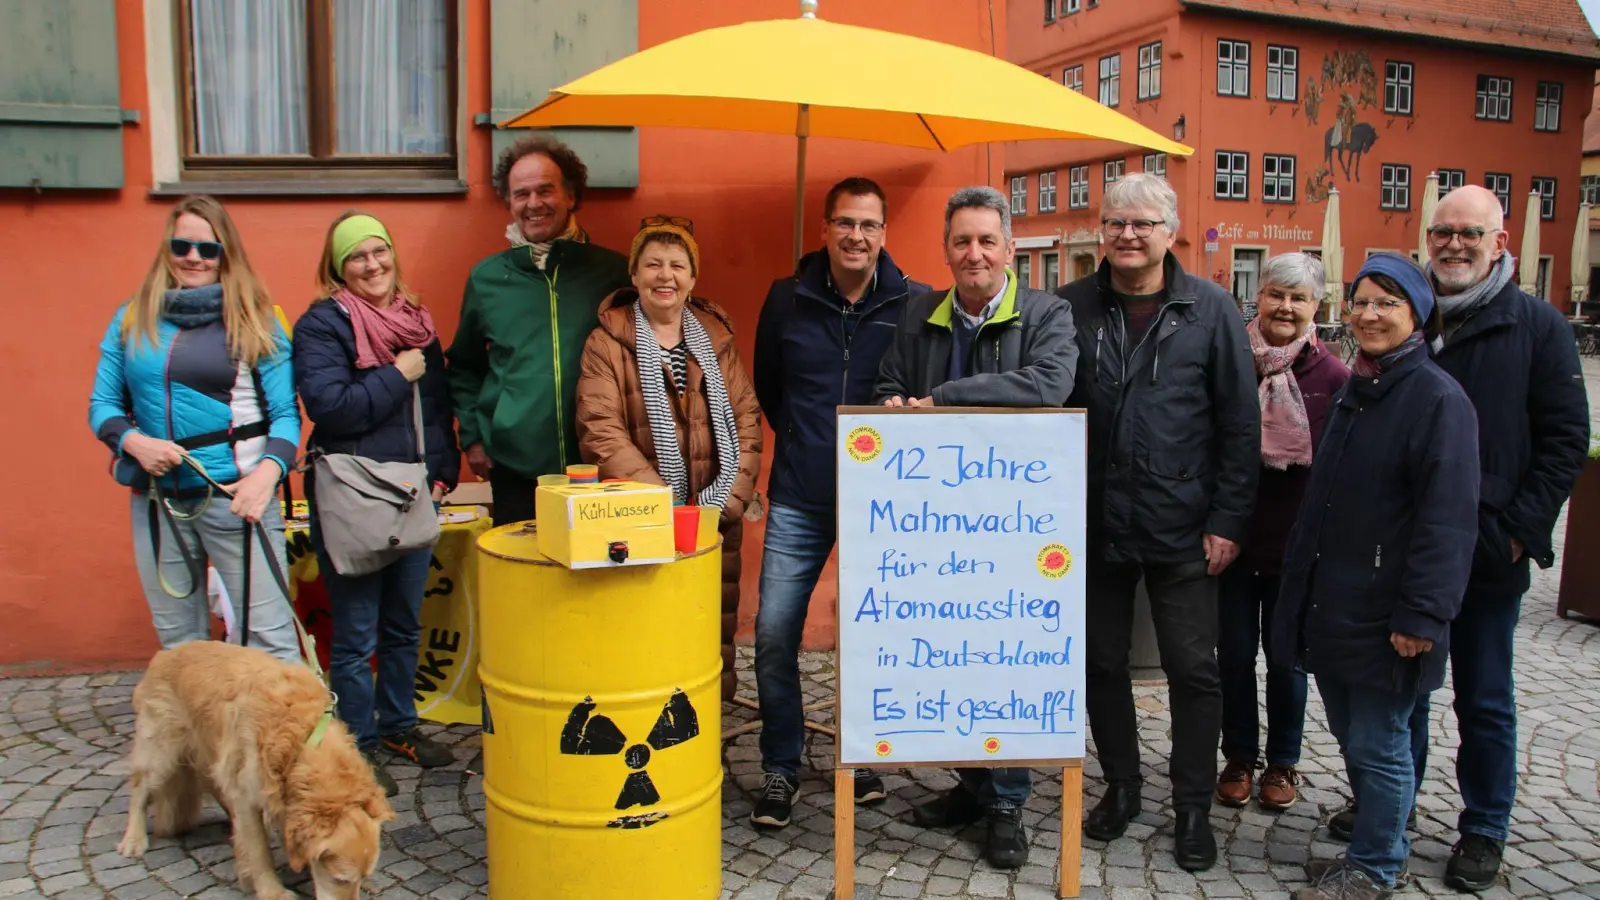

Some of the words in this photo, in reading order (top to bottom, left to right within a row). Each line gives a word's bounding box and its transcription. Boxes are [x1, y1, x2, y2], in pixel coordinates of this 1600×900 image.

[1216, 222, 1243, 241] Café
[849, 426, 882, 445] ATOMKRAFT?
[848, 447, 860, 460] NEIN
[861, 449, 881, 462] DANKE
[884, 447, 930, 480] 12
[938, 445, 1052, 488] Jahre
[870, 499, 1058, 534] Mahnwache
[877, 549, 927, 582] für
[938, 551, 995, 576] den
[1041, 569, 1057, 579] NEIN
[854, 587, 1061, 633] Atomausstieg
[412, 627, 461, 702] NKE
[877, 646, 898, 668] in
[906, 636, 1072, 669] Deutschland
[872, 687, 907, 722] Es
[916, 689, 950, 723] ist
[956, 689, 1076, 736] geschafft
